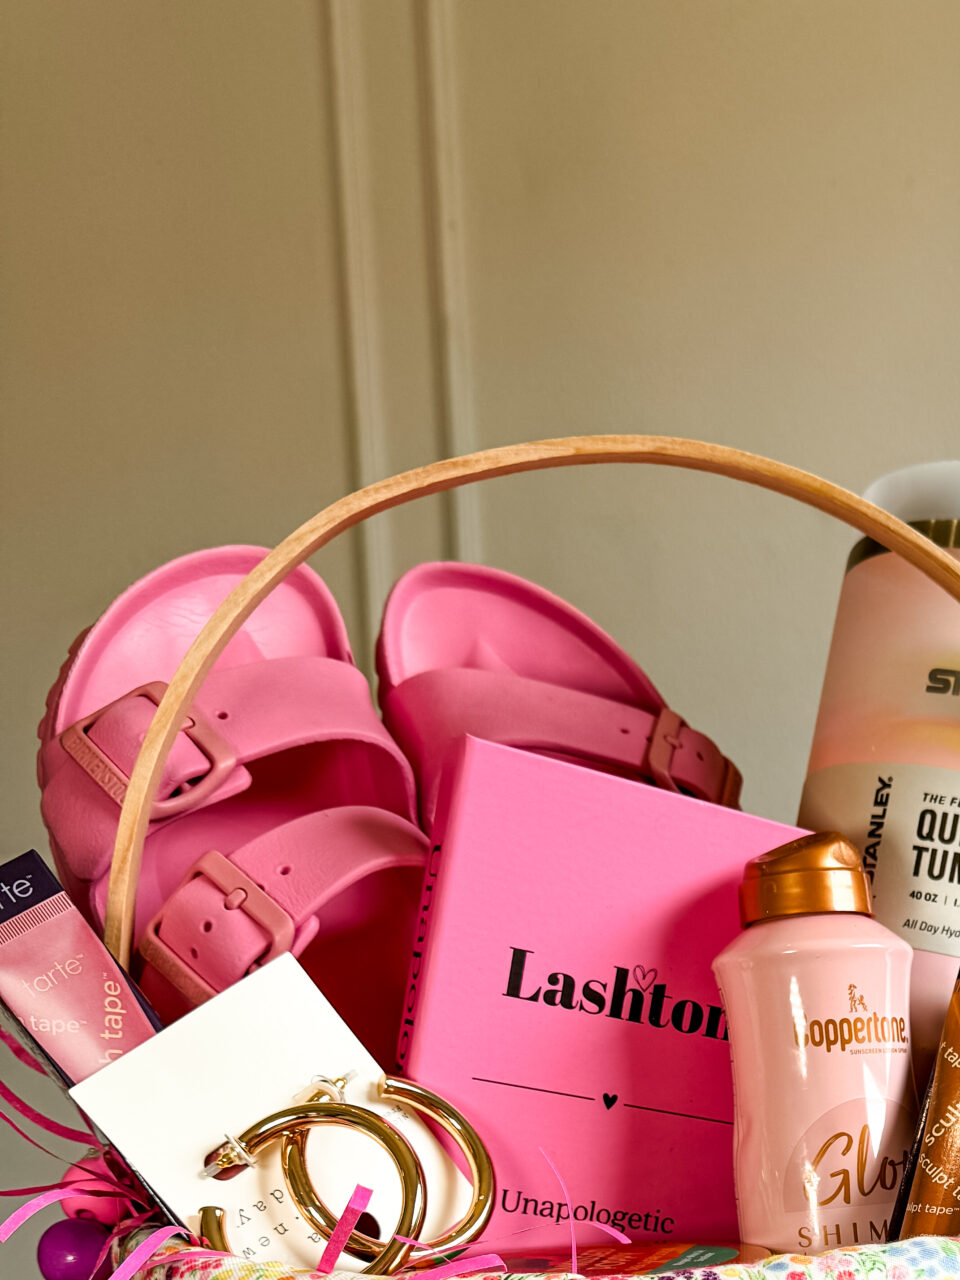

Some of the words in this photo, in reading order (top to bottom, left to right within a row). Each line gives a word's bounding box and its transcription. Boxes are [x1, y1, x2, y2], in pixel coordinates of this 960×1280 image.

[922, 792, 946, 806] THE
[909, 889, 923, 901] 40
[924, 892, 938, 903] OZ
[902, 918, 917, 930] All
[919, 920, 939, 936] Day
[919, 1152, 955, 1190] sculpt
[501, 1189, 675, 1234] Unapologetic
